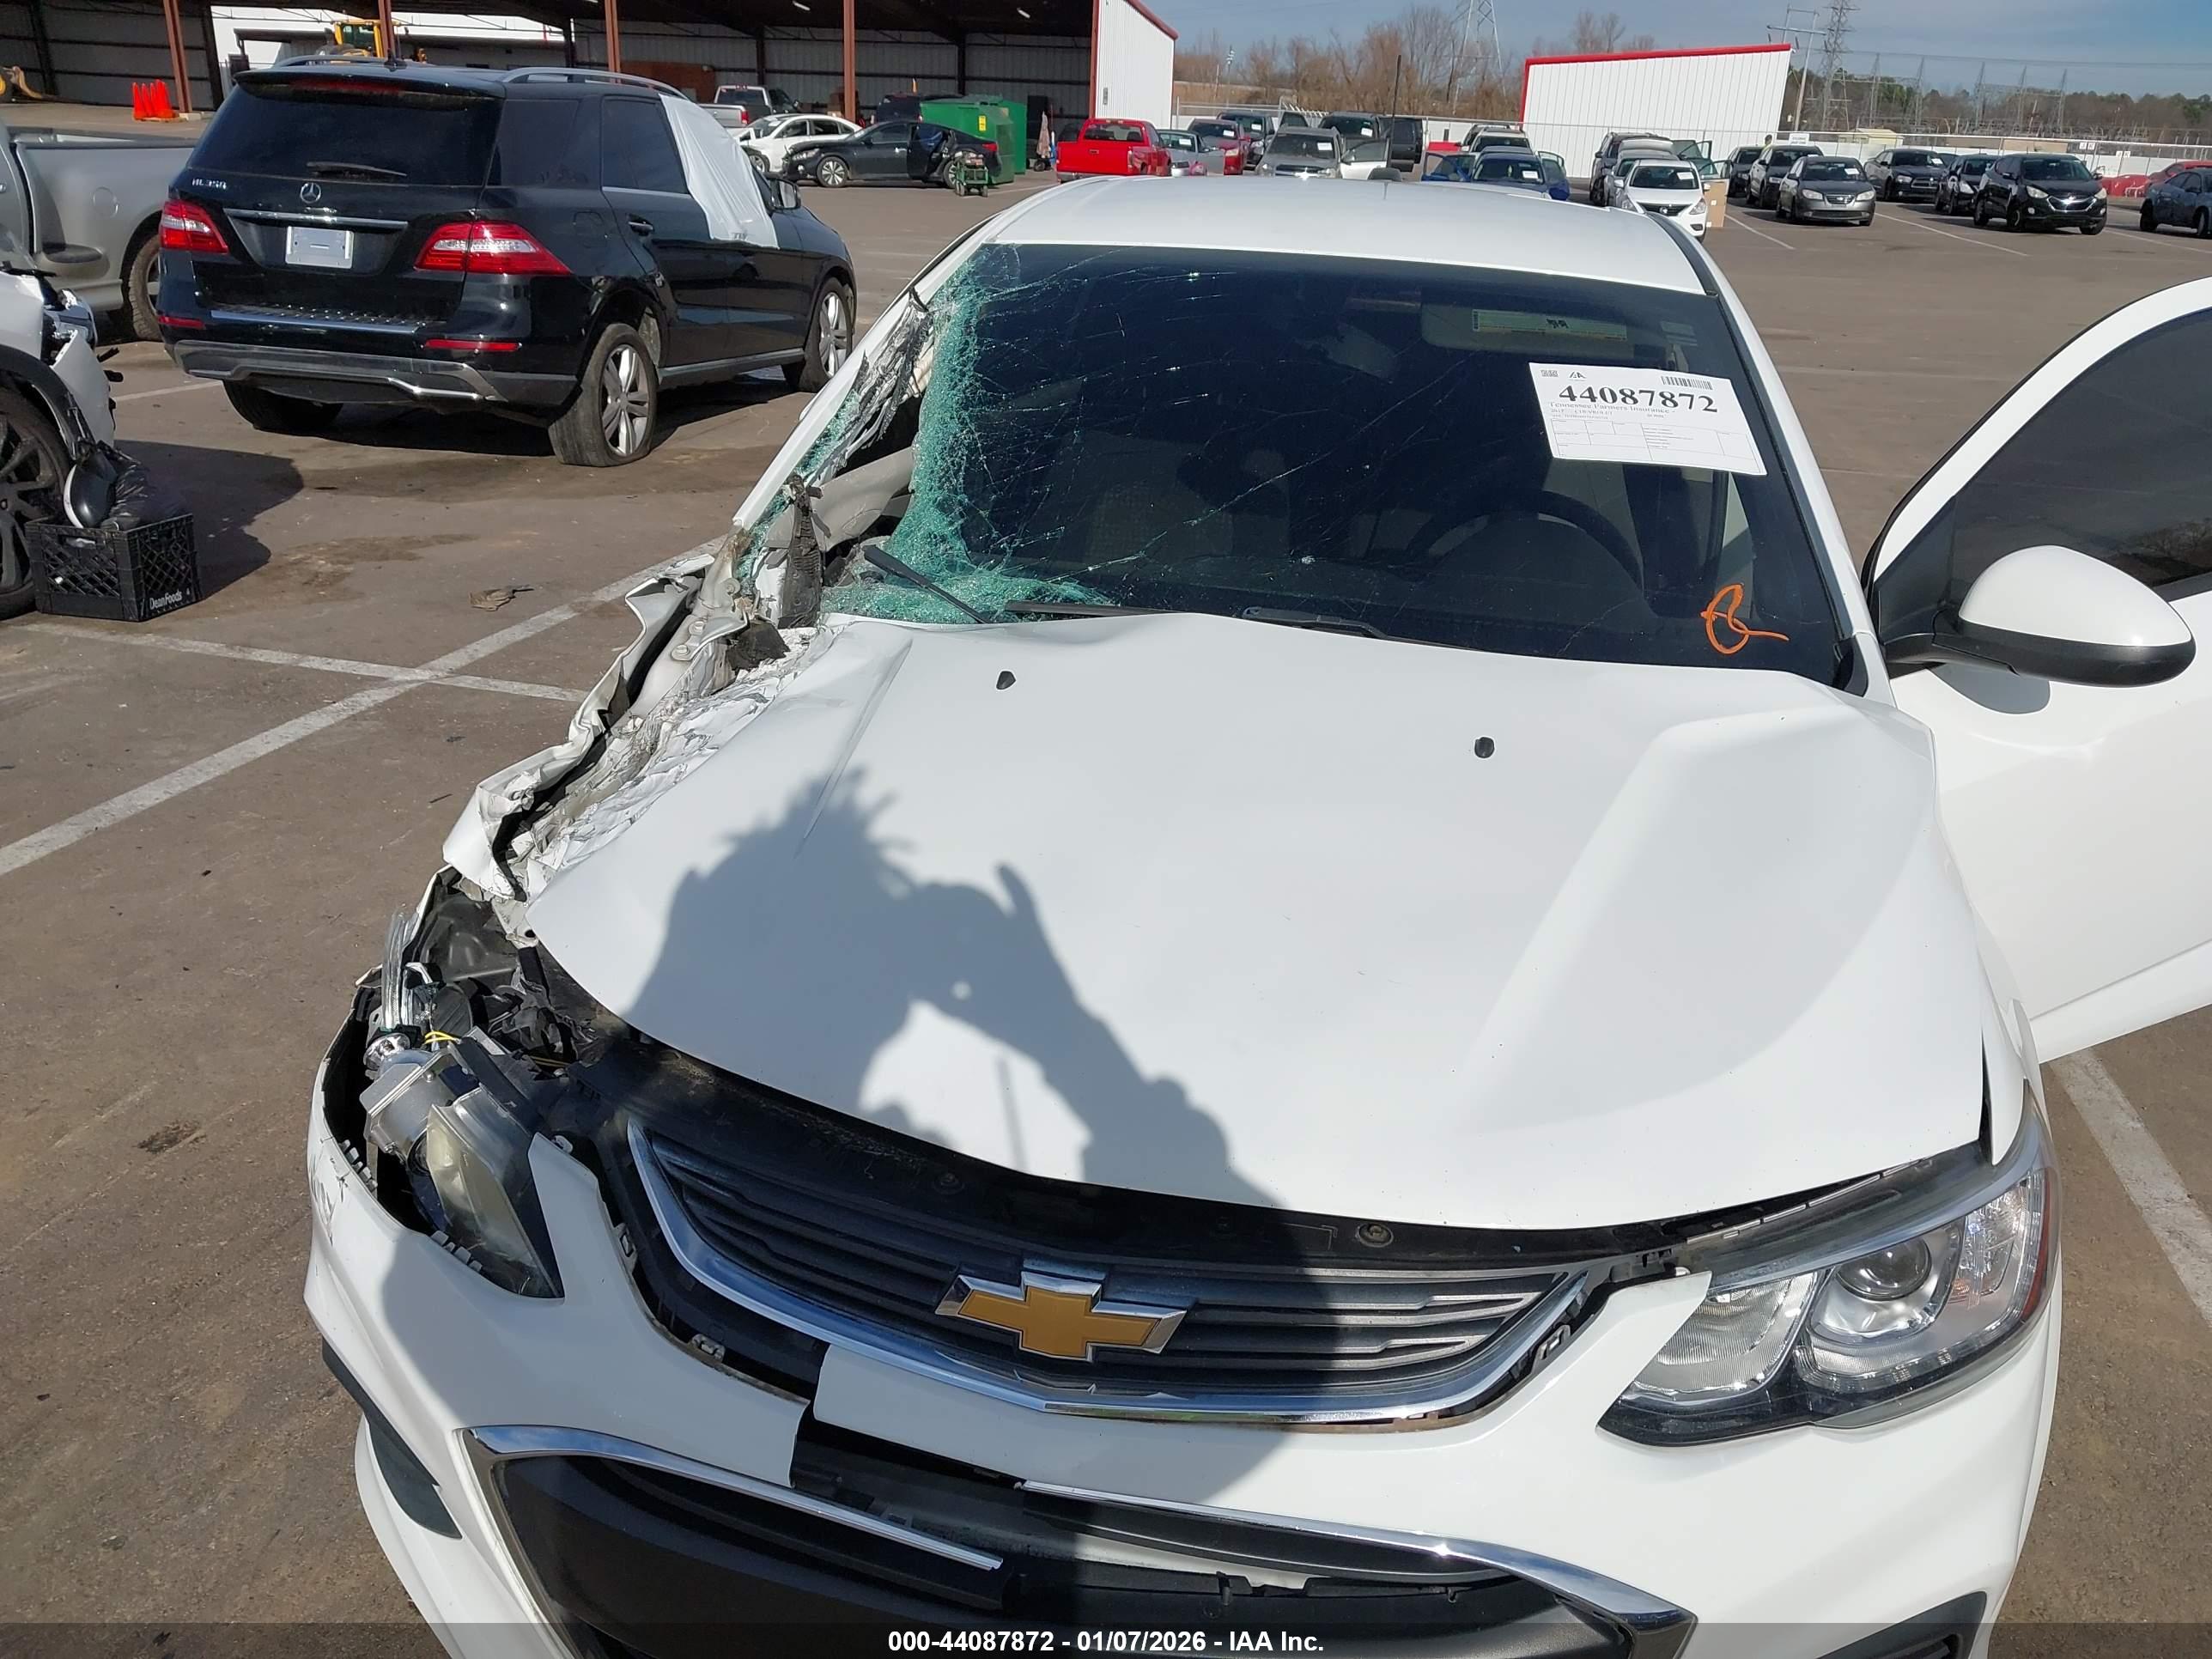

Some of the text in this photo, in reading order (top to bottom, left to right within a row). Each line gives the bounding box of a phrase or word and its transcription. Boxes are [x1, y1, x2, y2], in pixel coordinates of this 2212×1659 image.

[1550, 401, 1592, 410] Tennessee
[1631, 405, 1670, 414] Insurance
[1559, 385, 1718, 413] 44087872
